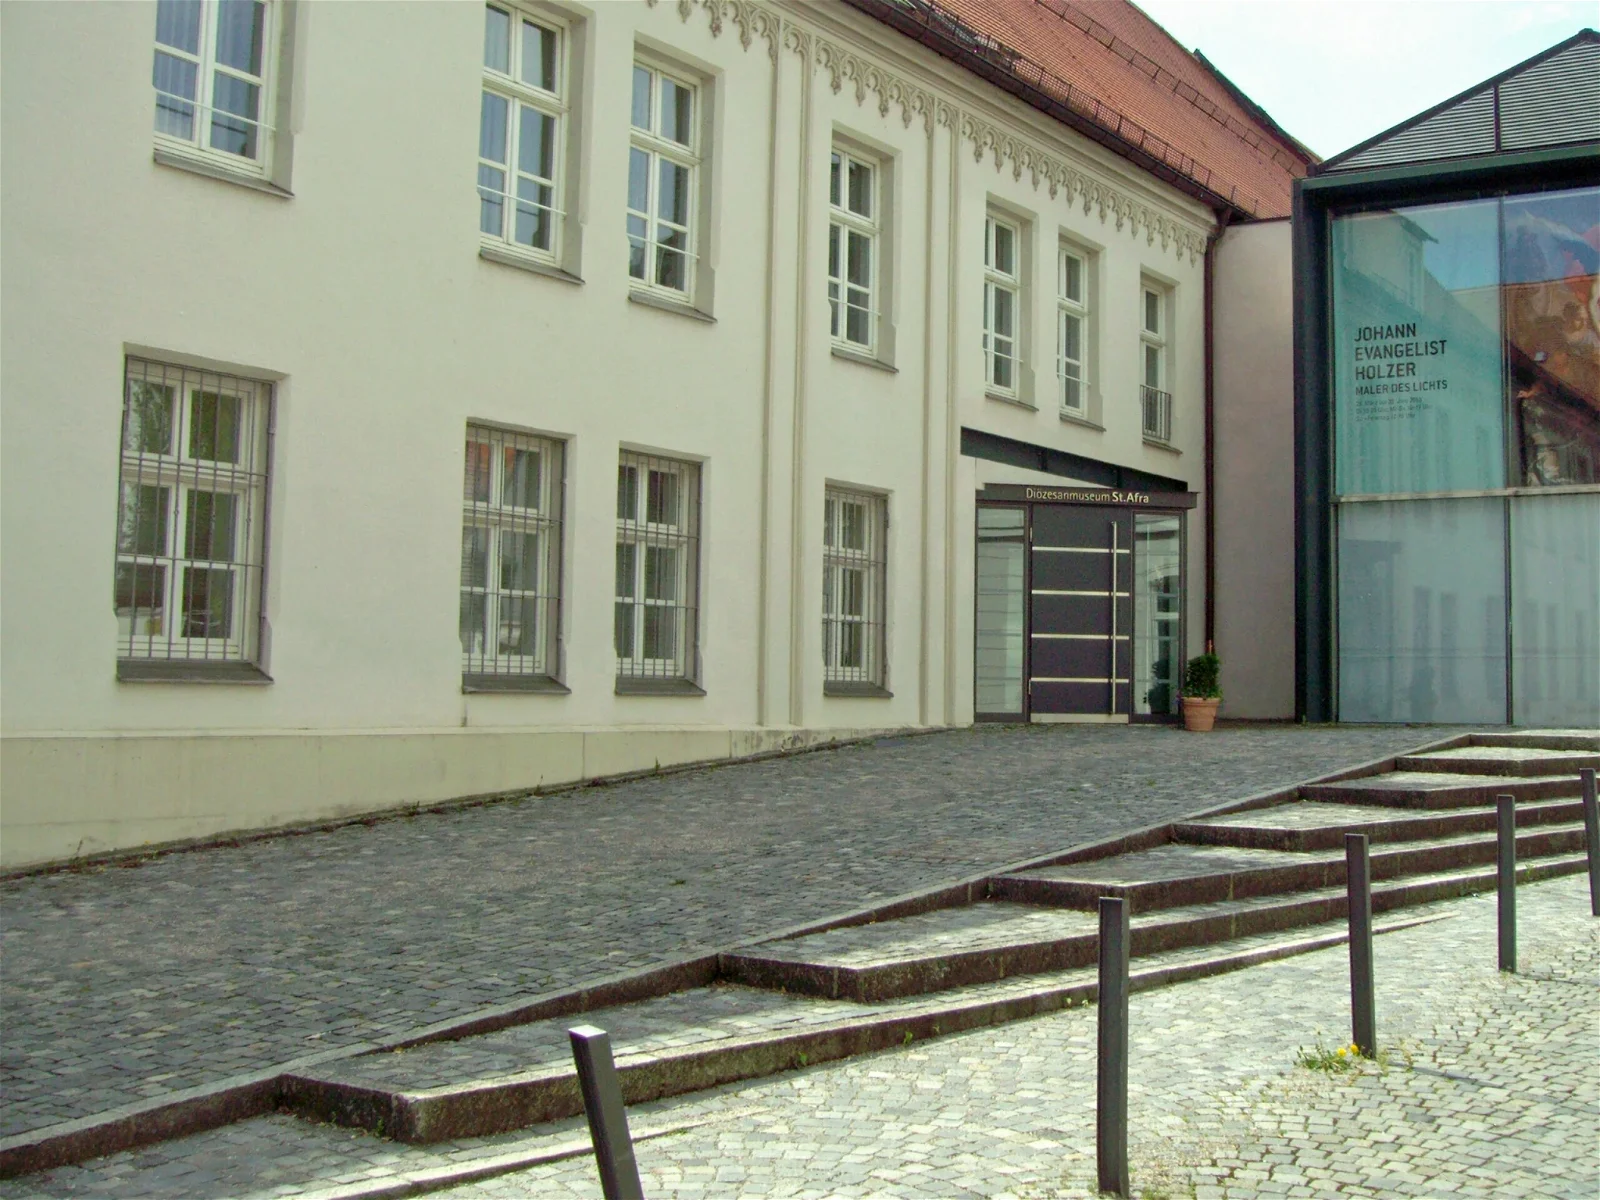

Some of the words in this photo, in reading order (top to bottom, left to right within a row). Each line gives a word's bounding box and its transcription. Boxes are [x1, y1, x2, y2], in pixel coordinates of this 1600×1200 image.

[1354, 323, 1416, 341] JOHANN
[1355, 339, 1447, 361] EVANGELIST
[1355, 362, 1416, 380] HOLZER
[1355, 384, 1389, 396] MALER
[1391, 382, 1411, 393] DES
[1413, 379, 1448, 391] LICHTS
[1026, 488, 1110, 502] Diözesanmuseum
